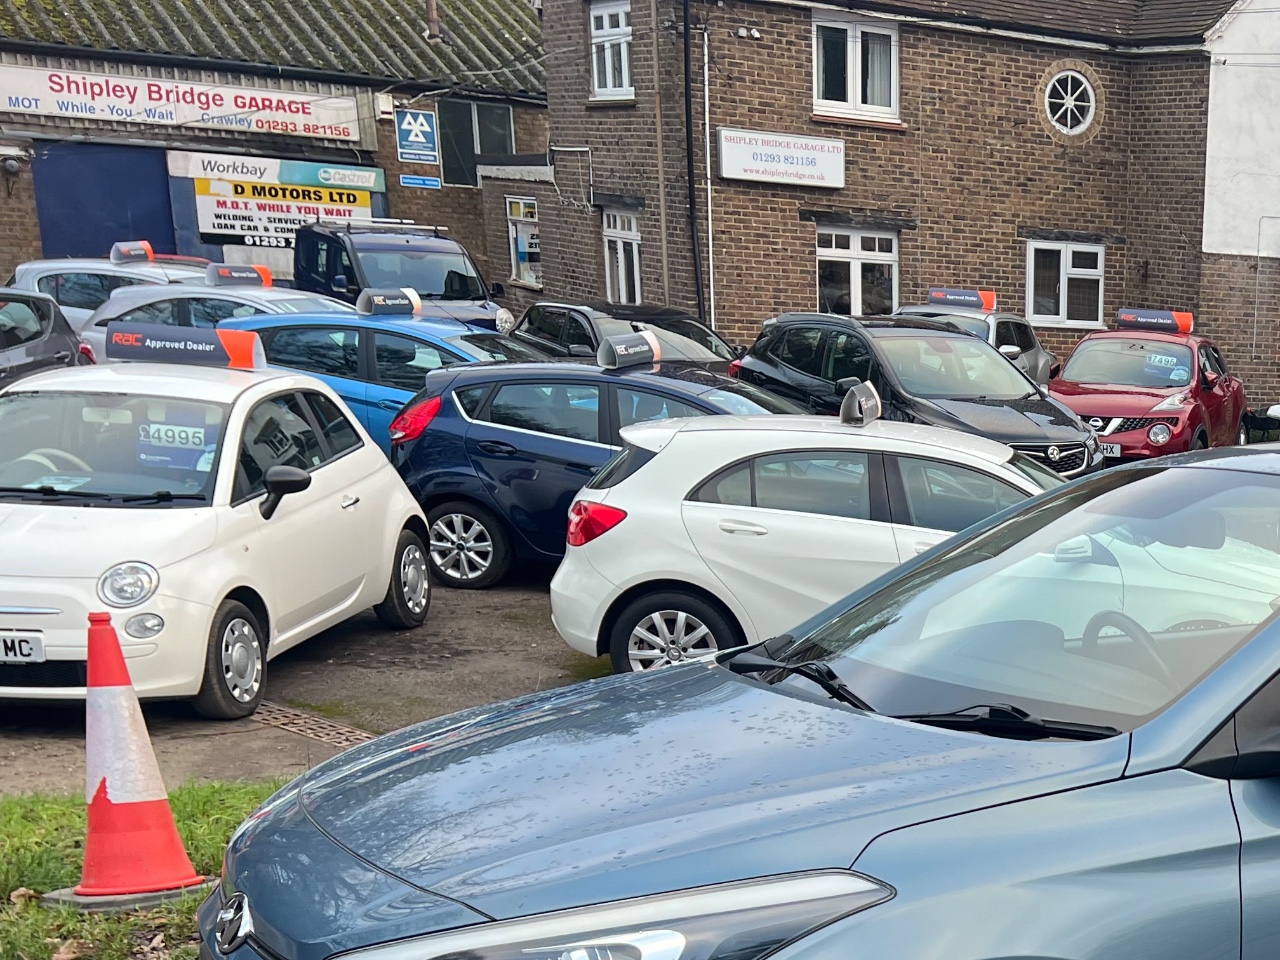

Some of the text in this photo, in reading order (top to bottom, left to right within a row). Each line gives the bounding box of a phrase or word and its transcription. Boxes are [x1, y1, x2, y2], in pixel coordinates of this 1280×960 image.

[48, 74, 312, 115] Shipley Bridge GARAGE
[8, 96, 40, 109] MOT
[56, 100, 96, 114] While
[107, 105, 133, 117] You
[144, 108, 174, 121] Wait
[201, 112, 253, 130] Crawley
[255, 119, 298, 132] 01293
[303, 122, 350, 137] 821156
[724, 135, 842, 154] SHIPLEY BRIDGE GARAGE LTD
[752, 151, 817, 167] 01293 821156
[201, 159, 267, 179] Workbay
[332, 169, 373, 185] Castrol
[742, 167, 825, 181] www.shipleybridge.co.uk
[251, 185, 323, 202] MOTORS
[329, 191, 357, 204] LTD
[216, 199, 353, 218] M.O.T. WHILE YOU WAIT
[214, 213, 254, 222] WELDING
[212, 222, 236, 231] LOAN
[240, 224, 259, 232] CAR
[244, 235, 286, 248] 01293
[145, 338, 185, 351] Approved
[186, 340, 216, 352] Dealer
[0, 638, 32, 657] MC
